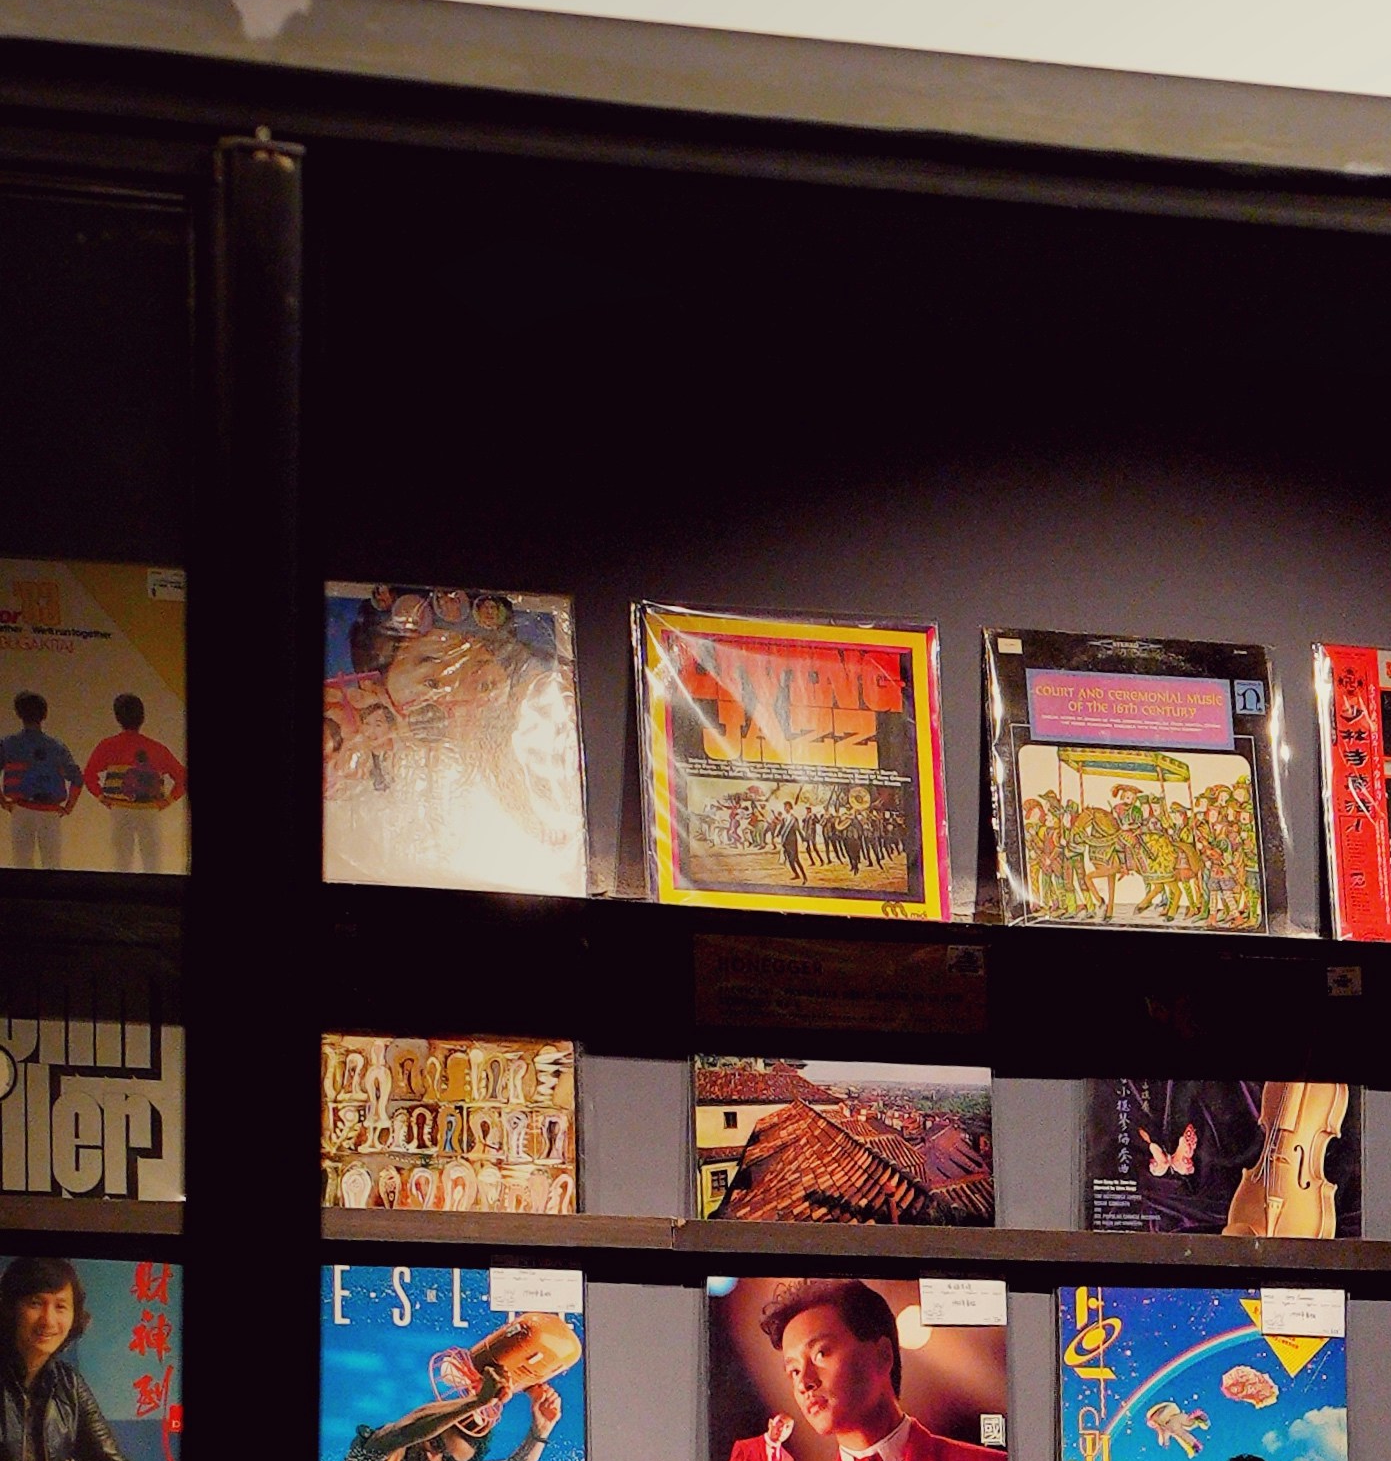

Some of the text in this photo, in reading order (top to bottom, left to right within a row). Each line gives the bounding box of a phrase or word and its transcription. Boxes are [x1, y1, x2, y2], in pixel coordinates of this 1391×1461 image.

[1035, 685, 1223, 706] COURT AND CEREMONIAL MUSIC
[1068, 700, 1197, 718] OF CENTURY
[702, 699, 880, 769] JAZZ
